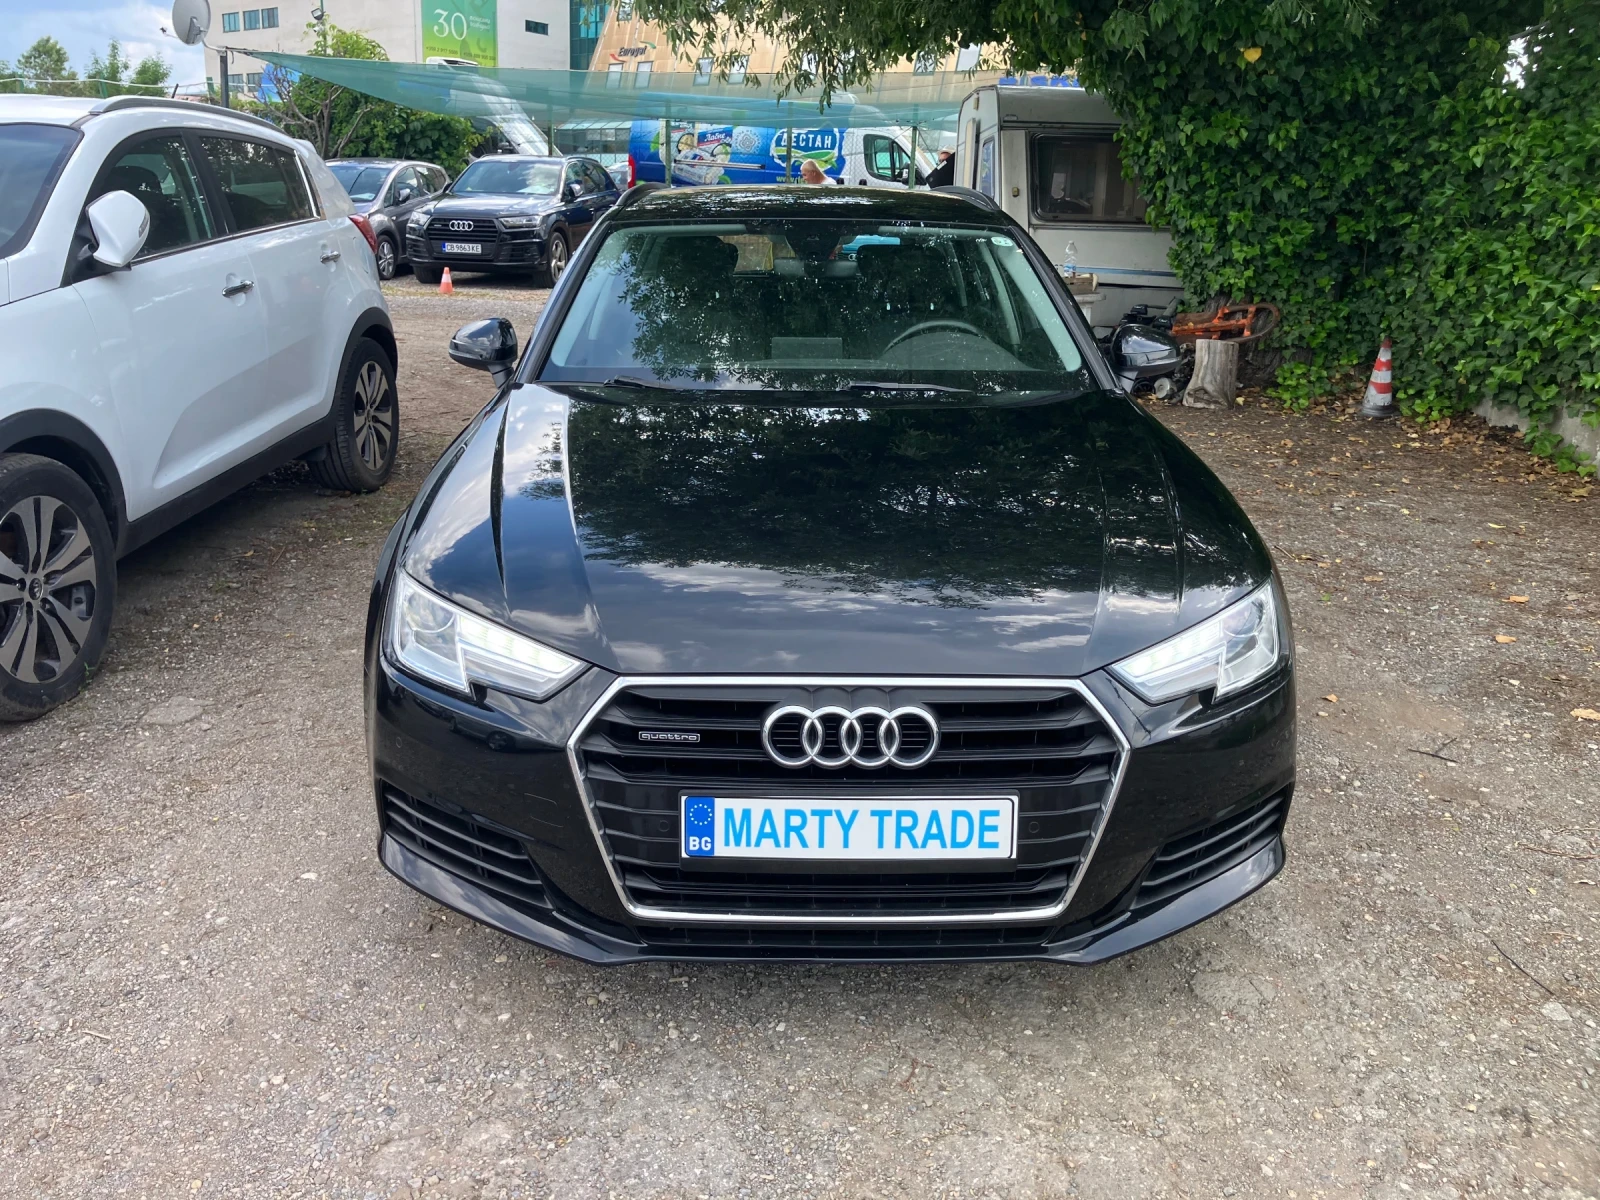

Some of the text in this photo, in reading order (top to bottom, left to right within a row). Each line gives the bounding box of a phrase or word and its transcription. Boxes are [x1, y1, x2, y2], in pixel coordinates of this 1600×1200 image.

[433, 8, 467, 40] 30
[641, 733, 698, 741] quattro
[723, 808, 1001, 849] MARTY TRADE
[689, 836, 712, 851] BG
